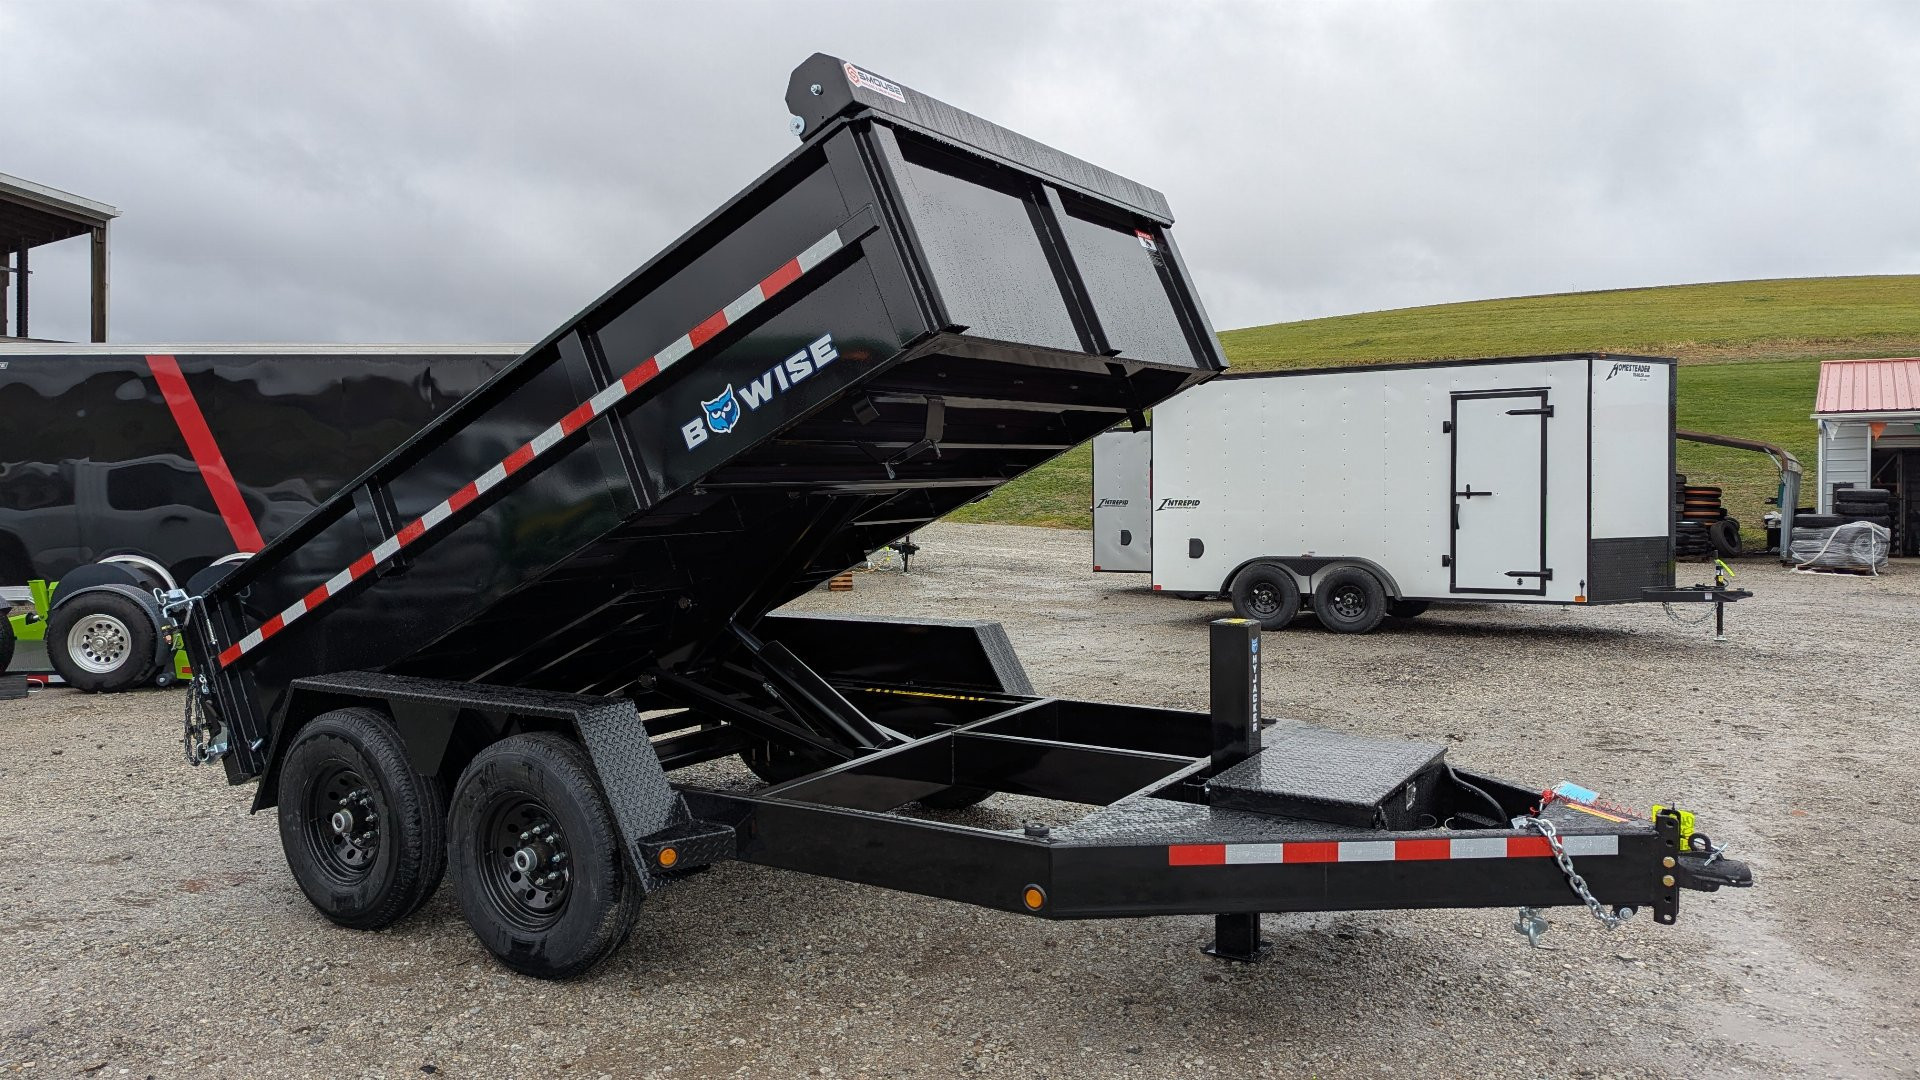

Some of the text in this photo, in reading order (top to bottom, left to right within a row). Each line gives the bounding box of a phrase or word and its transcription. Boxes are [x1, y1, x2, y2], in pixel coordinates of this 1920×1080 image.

[857, 71, 903, 96] SMOUSE
[1606, 363, 1651, 381] HOMESTEADER
[1096, 498, 1129, 509] INTREPID
[1155, 498, 1201, 511] INTREPID
